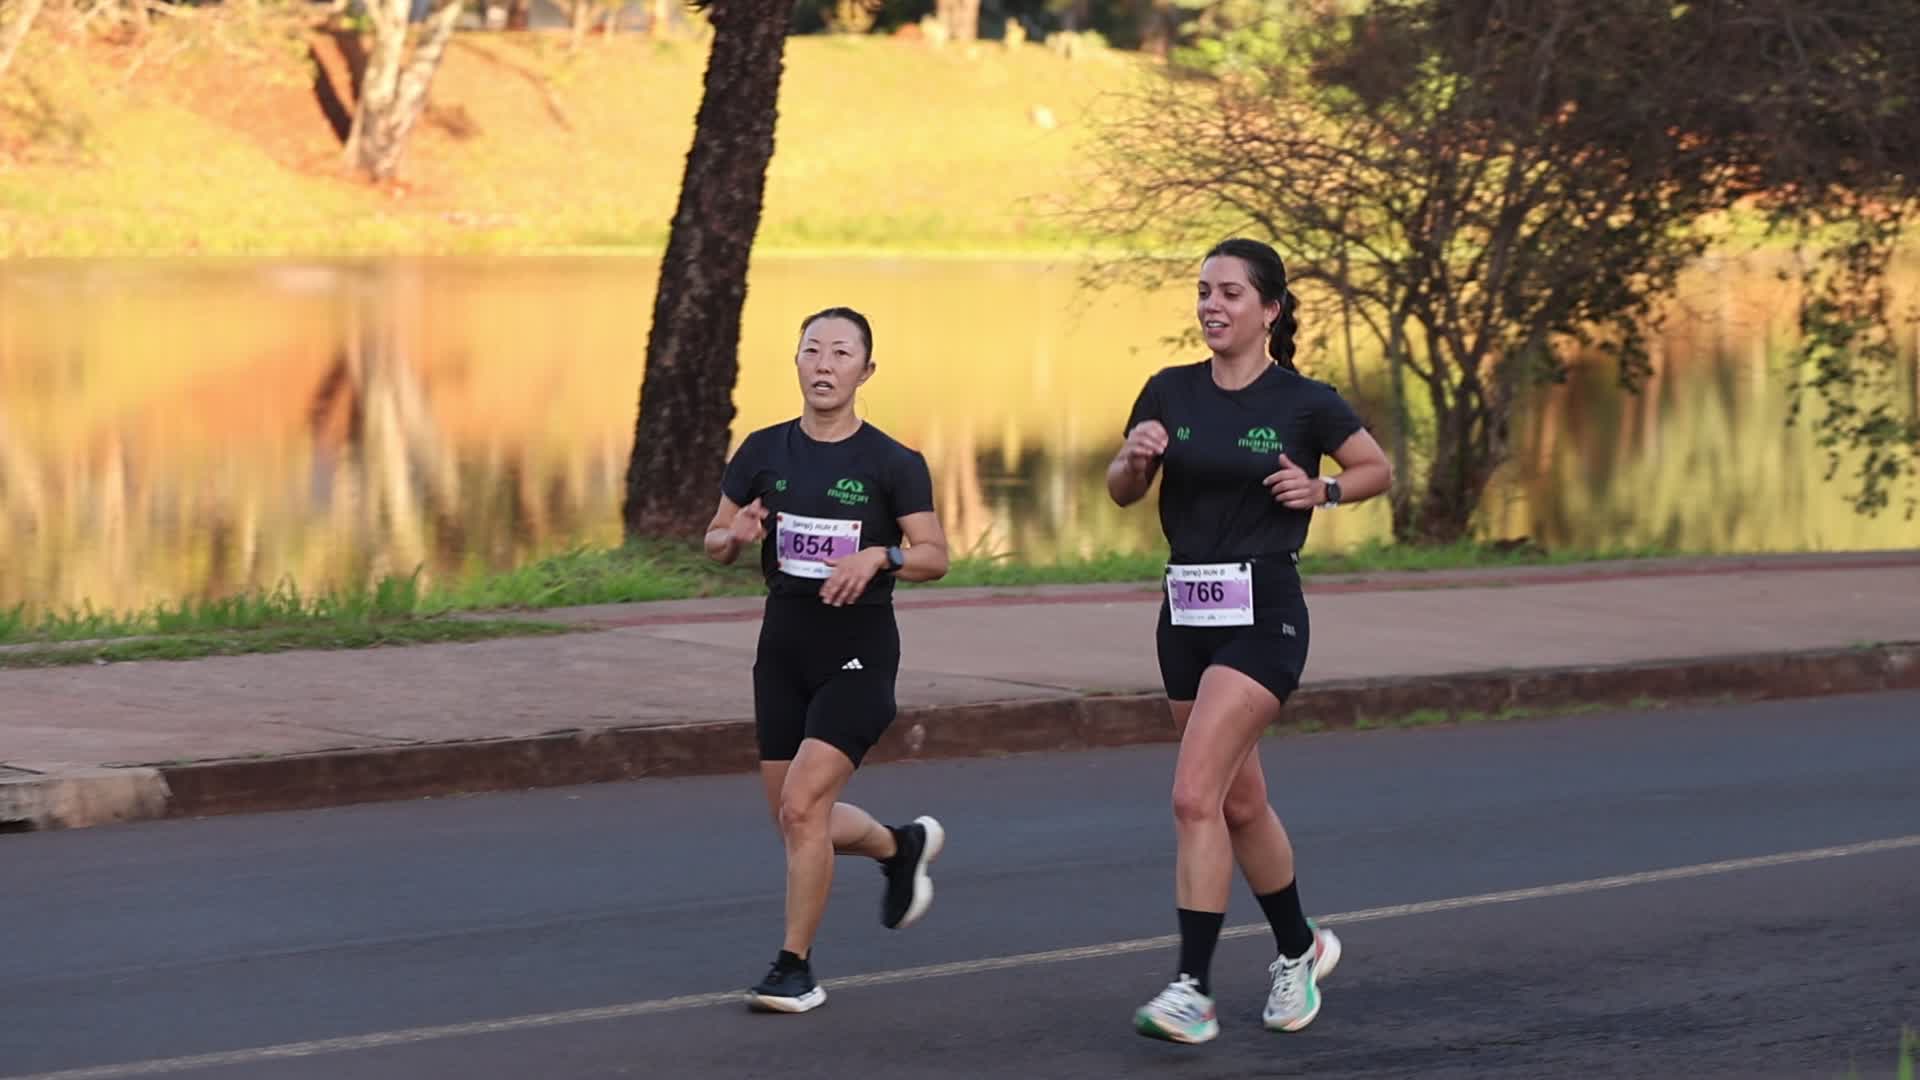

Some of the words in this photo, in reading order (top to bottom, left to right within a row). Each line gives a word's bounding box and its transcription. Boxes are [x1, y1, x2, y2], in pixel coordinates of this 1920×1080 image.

[792, 533, 834, 556] 654
[1203, 568, 1218, 577] RUN
[1184, 581, 1225, 603] 766
